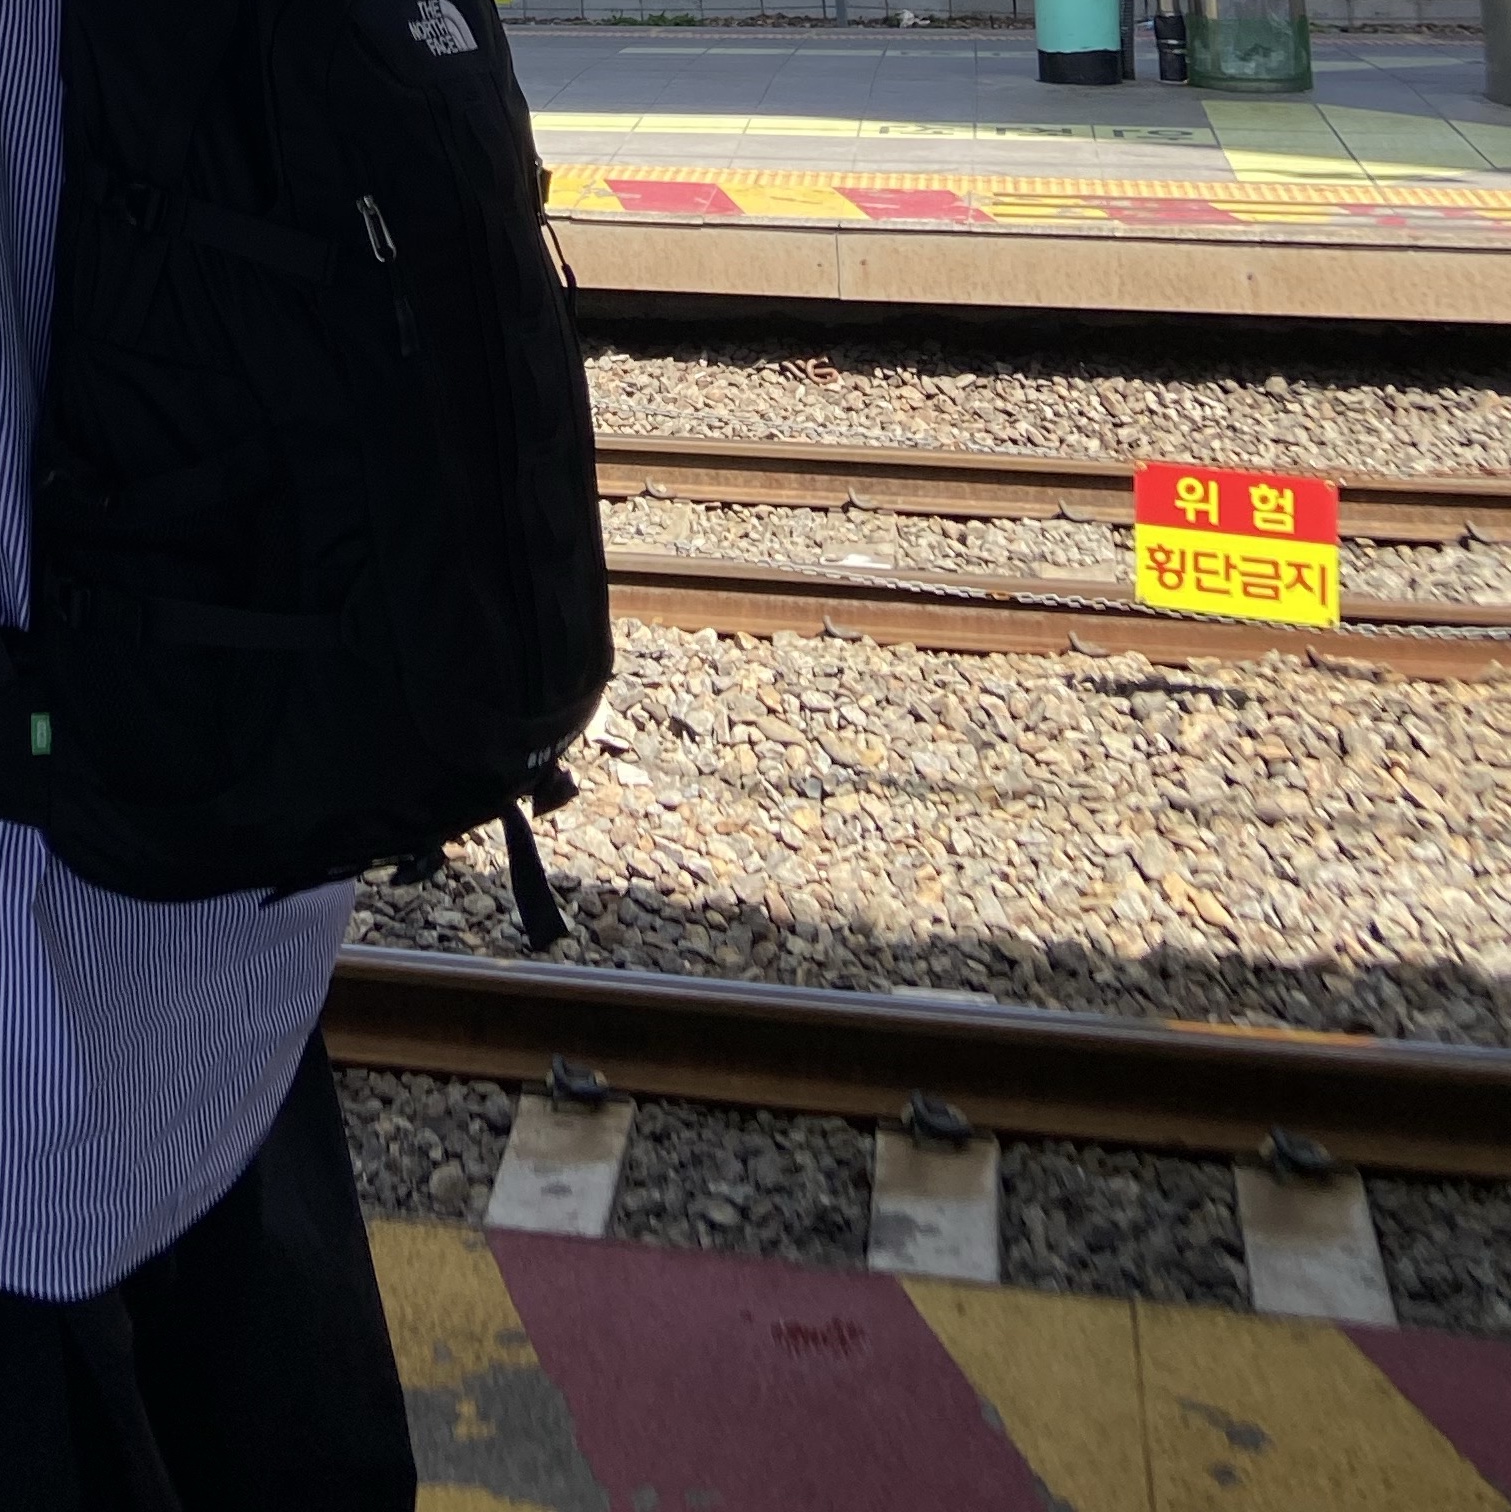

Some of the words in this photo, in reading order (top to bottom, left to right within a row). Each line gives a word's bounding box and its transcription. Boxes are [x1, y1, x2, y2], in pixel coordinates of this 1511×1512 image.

[408, 17, 448, 41] NORTH
[426, 35, 459, 56] FACE
[1174, 476, 1295, 534] 위험
[1145, 543, 1328, 607] 횡단금지
